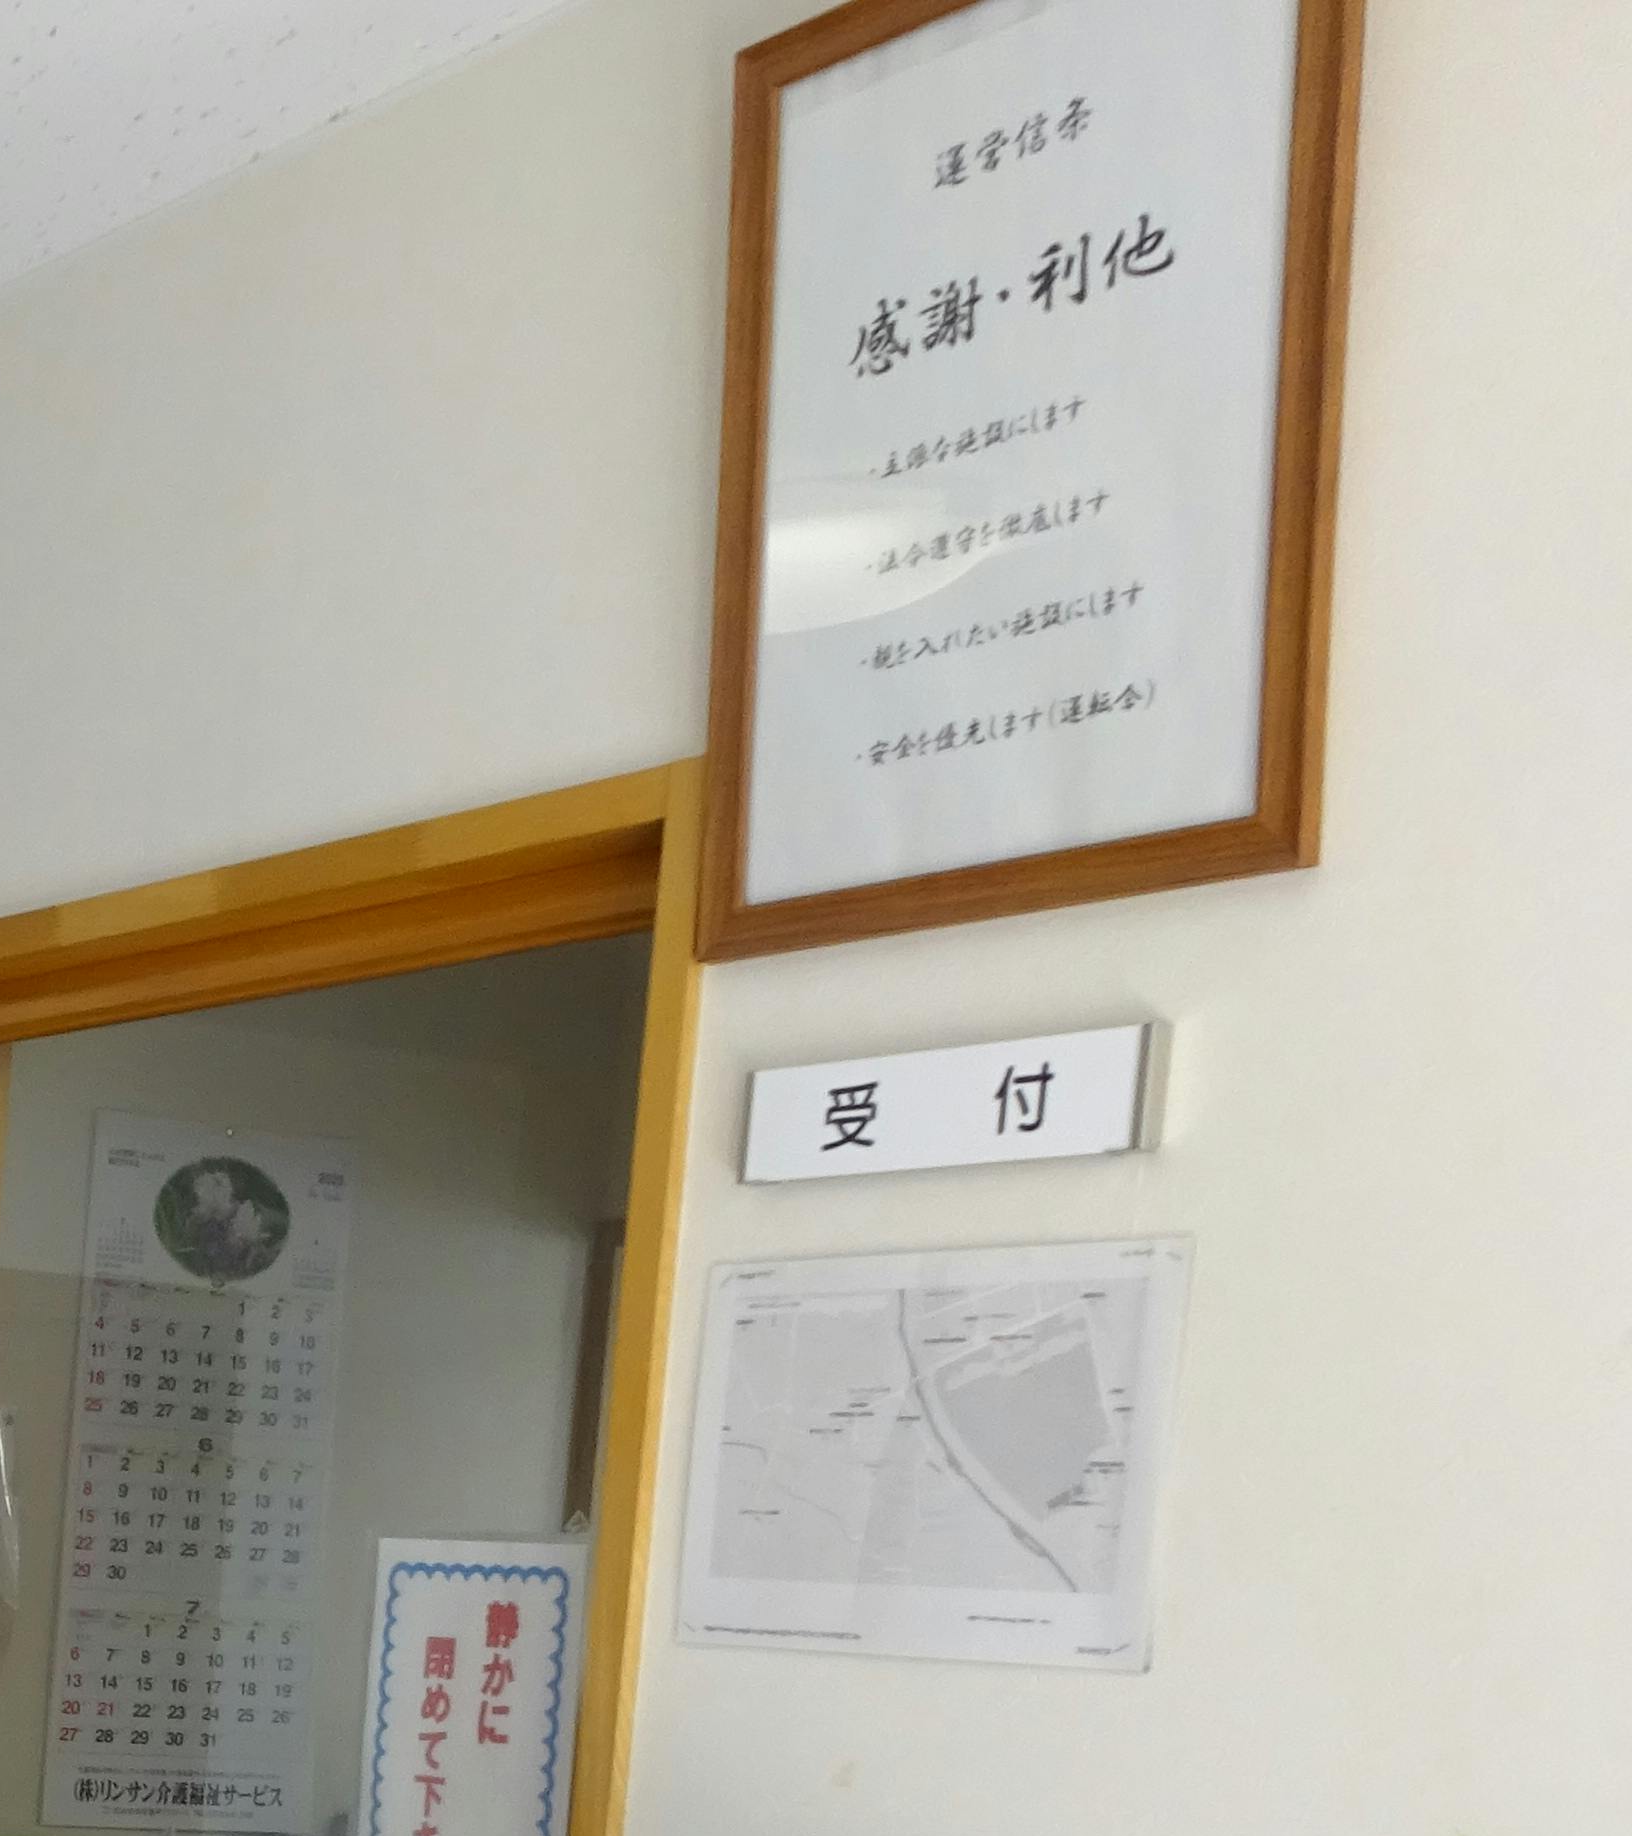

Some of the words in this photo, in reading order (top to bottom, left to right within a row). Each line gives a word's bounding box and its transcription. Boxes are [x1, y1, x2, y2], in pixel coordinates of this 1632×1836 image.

[932, 97, 1092, 190] 運営信条
[848, 212, 1176, 380] 感謝・利他
[821, 1061, 1054, 1153] 受付
[238, 1300, 245, 1316] 1
[94, 1315, 105, 1330] 4
[130, 1318, 141, 1334] 5
[165, 1321, 176, 1337] 6
[202, 1324, 211, 1340] 7
[234, 1327, 245, 1344] 8
[91, 1342, 106, 1357] 11
[126, 1345, 144, 1361] 12
[161, 1348, 179, 1365] 13
[197, 1351, 213, 1367] 14
[230, 1354, 246, 1371] 15
[265, 1357, 281, 1374] 16
[89, 1369, 105, 1386] 18
[124, 1373, 142, 1388] 19
[157, 1375, 177, 1392] 20
[192, 1378, 210, 1394] 21
[226, 1381, 242, 1397] 22
[260, 1384, 279, 1401] 23
[84, 1396, 103, 1412] 25
[120, 1399, 139, 1416] 26
[155, 1402, 175, 1418] 27
[190, 1405, 209, 1422] 28
[224, 1408, 243, 1424] 29
[259, 1411, 278, 1427] 30
[198, 1437, 213, 1453] 6
[87, 1454, 93, 1469] 1
[120, 1456, 131, 1472] 2
[155, 1458, 165, 1474] 3
[190, 1462, 200, 1477] 4
[225, 1463, 234, 1480] 5
[259, 1466, 269, 1482] 6
[82, 1480, 93, 1497] 8
[118, 1482, 129, 1499] 9
[151, 1486, 168, 1502] 10
[186, 1489, 201, 1504] 11
[219, 1491, 236, 1507] 12
[255, 1493, 271, 1509] 13
[78, 1507, 95, 1524] 15
[113, 1510, 131, 1526] 16
[149, 1513, 166, 1528] 17
[184, 1515, 201, 1531] 18
[217, 1517, 234, 1533] 19
[250, 1520, 269, 1536] 20
[74, 1535, 94, 1551] 22
[109, 1537, 128, 1553] 23
[145, 1540, 163, 1555] 24
[179, 1542, 199, 1558] 25
[214, 1544, 231, 1560] 26
[249, 1547, 267, 1562] 27
[72, 1562, 92, 1578] 29
[107, 1564, 127, 1581] 30
[187, 1600, 200, 1615] 7
[144, 1623, 151, 1638] 1
[177, 1624, 188, 1640] 2
[211, 1626, 221, 1642] 3
[246, 1629, 256, 1643] 4
[69, 1646, 80, 1661] 6
[106, 1647, 118, 1662] 7
[140, 1649, 151, 1665] 8
[175, 1651, 186, 1667] 9
[206, 1653, 224, 1668] 10
[242, 1654, 256, 1670] 11
[66, 1673, 82, 1688] 13
[101, 1675, 118, 1689] 14
[136, 1676, 153, 1692] 15
[171, 1678, 188, 1693] 16
[205, 1680, 221, 1695] 17
[240, 1681, 257, 1697] 18
[61, 1700, 81, 1715] 20
[96, 1701, 114, 1717] 21
[132, 1703, 152, 1719] 22
[167, 1704, 186, 1720] 23
[201, 1706, 219, 1722] 24
[237, 1707, 255, 1723] 25
[59, 1726, 79, 1742] 27
[95, 1728, 114, 1744] 28
[130, 1729, 150, 1745] 29
[165, 1731, 184, 1747] 30
[199, 1732, 216, 1748] 31
